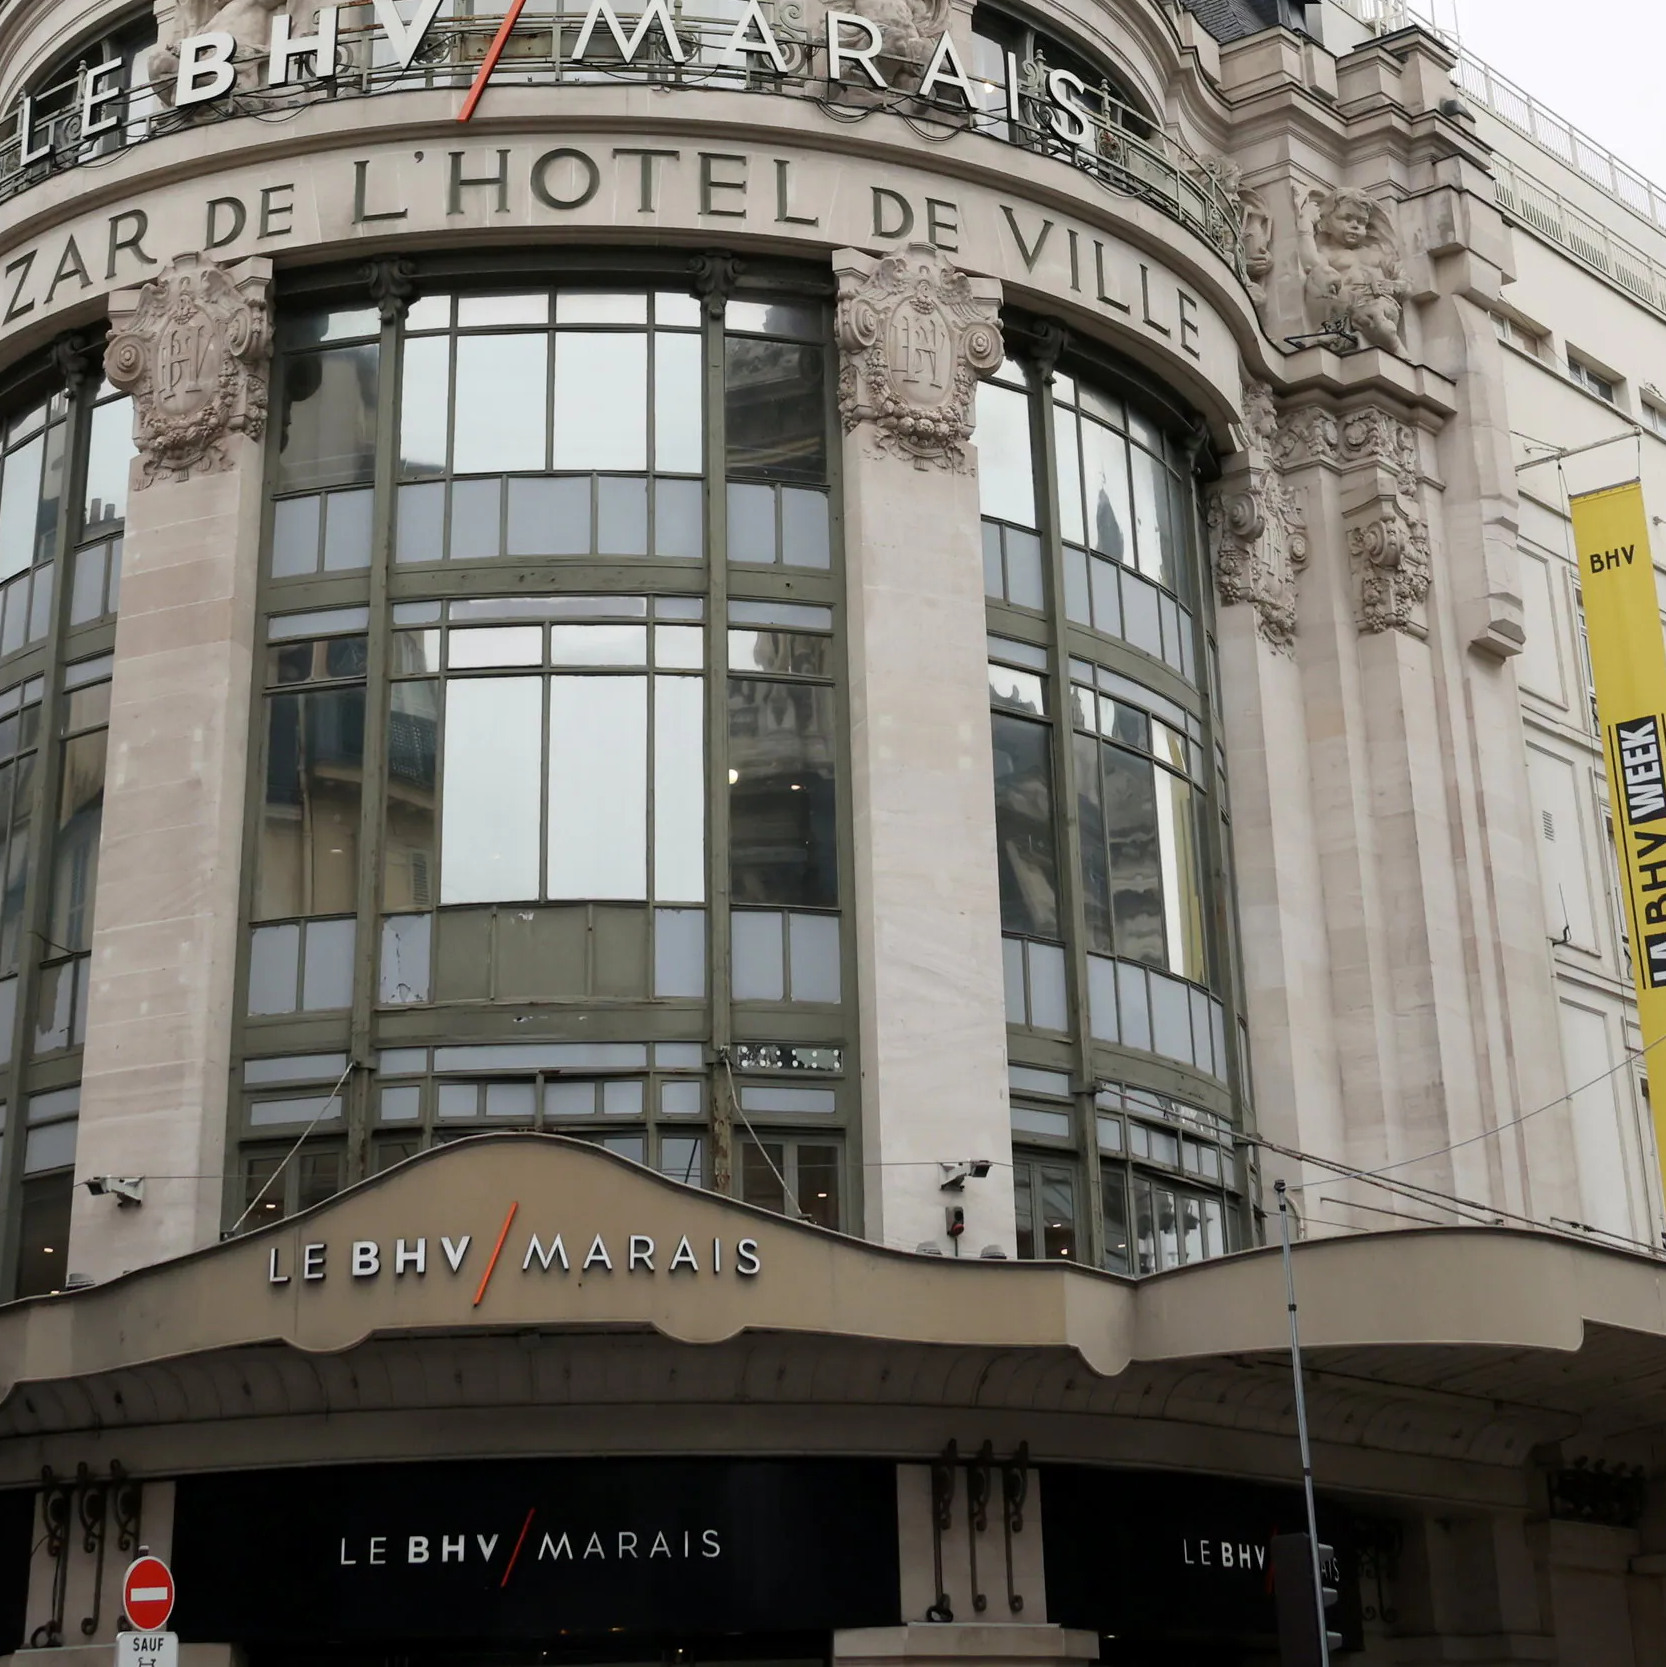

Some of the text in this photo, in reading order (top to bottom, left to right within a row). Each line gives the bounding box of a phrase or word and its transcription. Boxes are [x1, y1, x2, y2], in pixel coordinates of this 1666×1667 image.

[19, 56, 127, 168] LE
[204, 182, 295, 252] DE
[353, 146, 819, 227] L'HOTEL
[870, 186, 958, 254] DE
[1000, 204, 1202, 360] VILLE
[1590, 545, 1635, 574] BHV
[1619, 722, 1666, 818] WEEK
[268, 1233, 762, 1285] LE BHV MARAIS
[340, 1529, 721, 1565] LE BHV MARAIS
[1184, 1538, 1211, 1566] LE
[1221, 1542, 1265, 1570] BHV
[133, 1637, 164, 1652] SAUF
